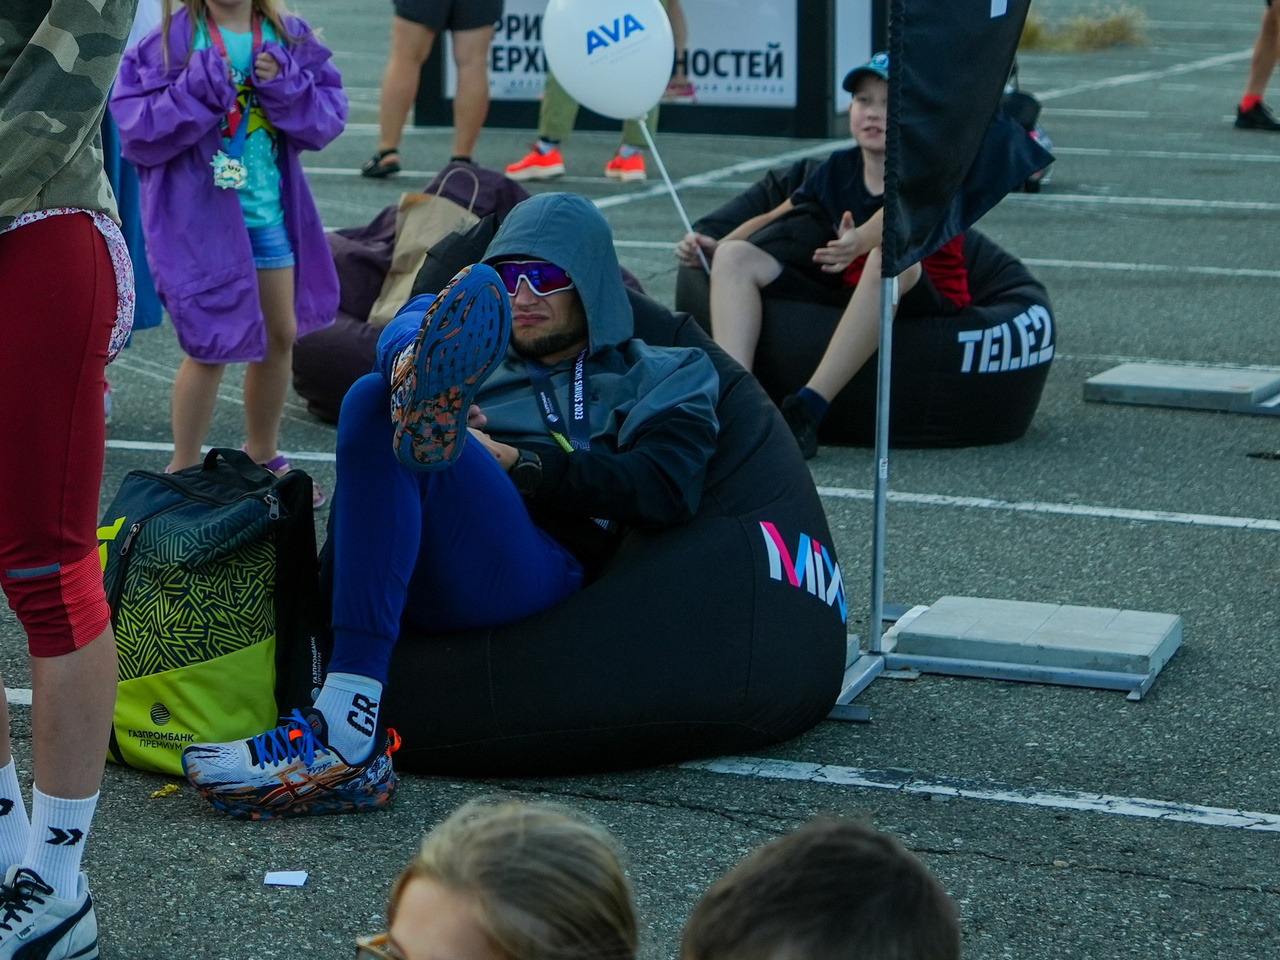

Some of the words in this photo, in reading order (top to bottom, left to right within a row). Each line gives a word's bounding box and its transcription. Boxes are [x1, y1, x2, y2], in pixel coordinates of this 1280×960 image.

[587, 13, 645, 55] AVA
[958, 304, 1054, 373] TELE2
[574, 380, 584, 402] SIRIUS
[574, 403, 584, 420] 2023
[759, 521, 847, 624] MIX
[347, 693, 378, 737] GR
[128, 729, 195, 743] ГАЗПРОМБАНК
[139, 739, 183, 751] ПРЕМИУМ
